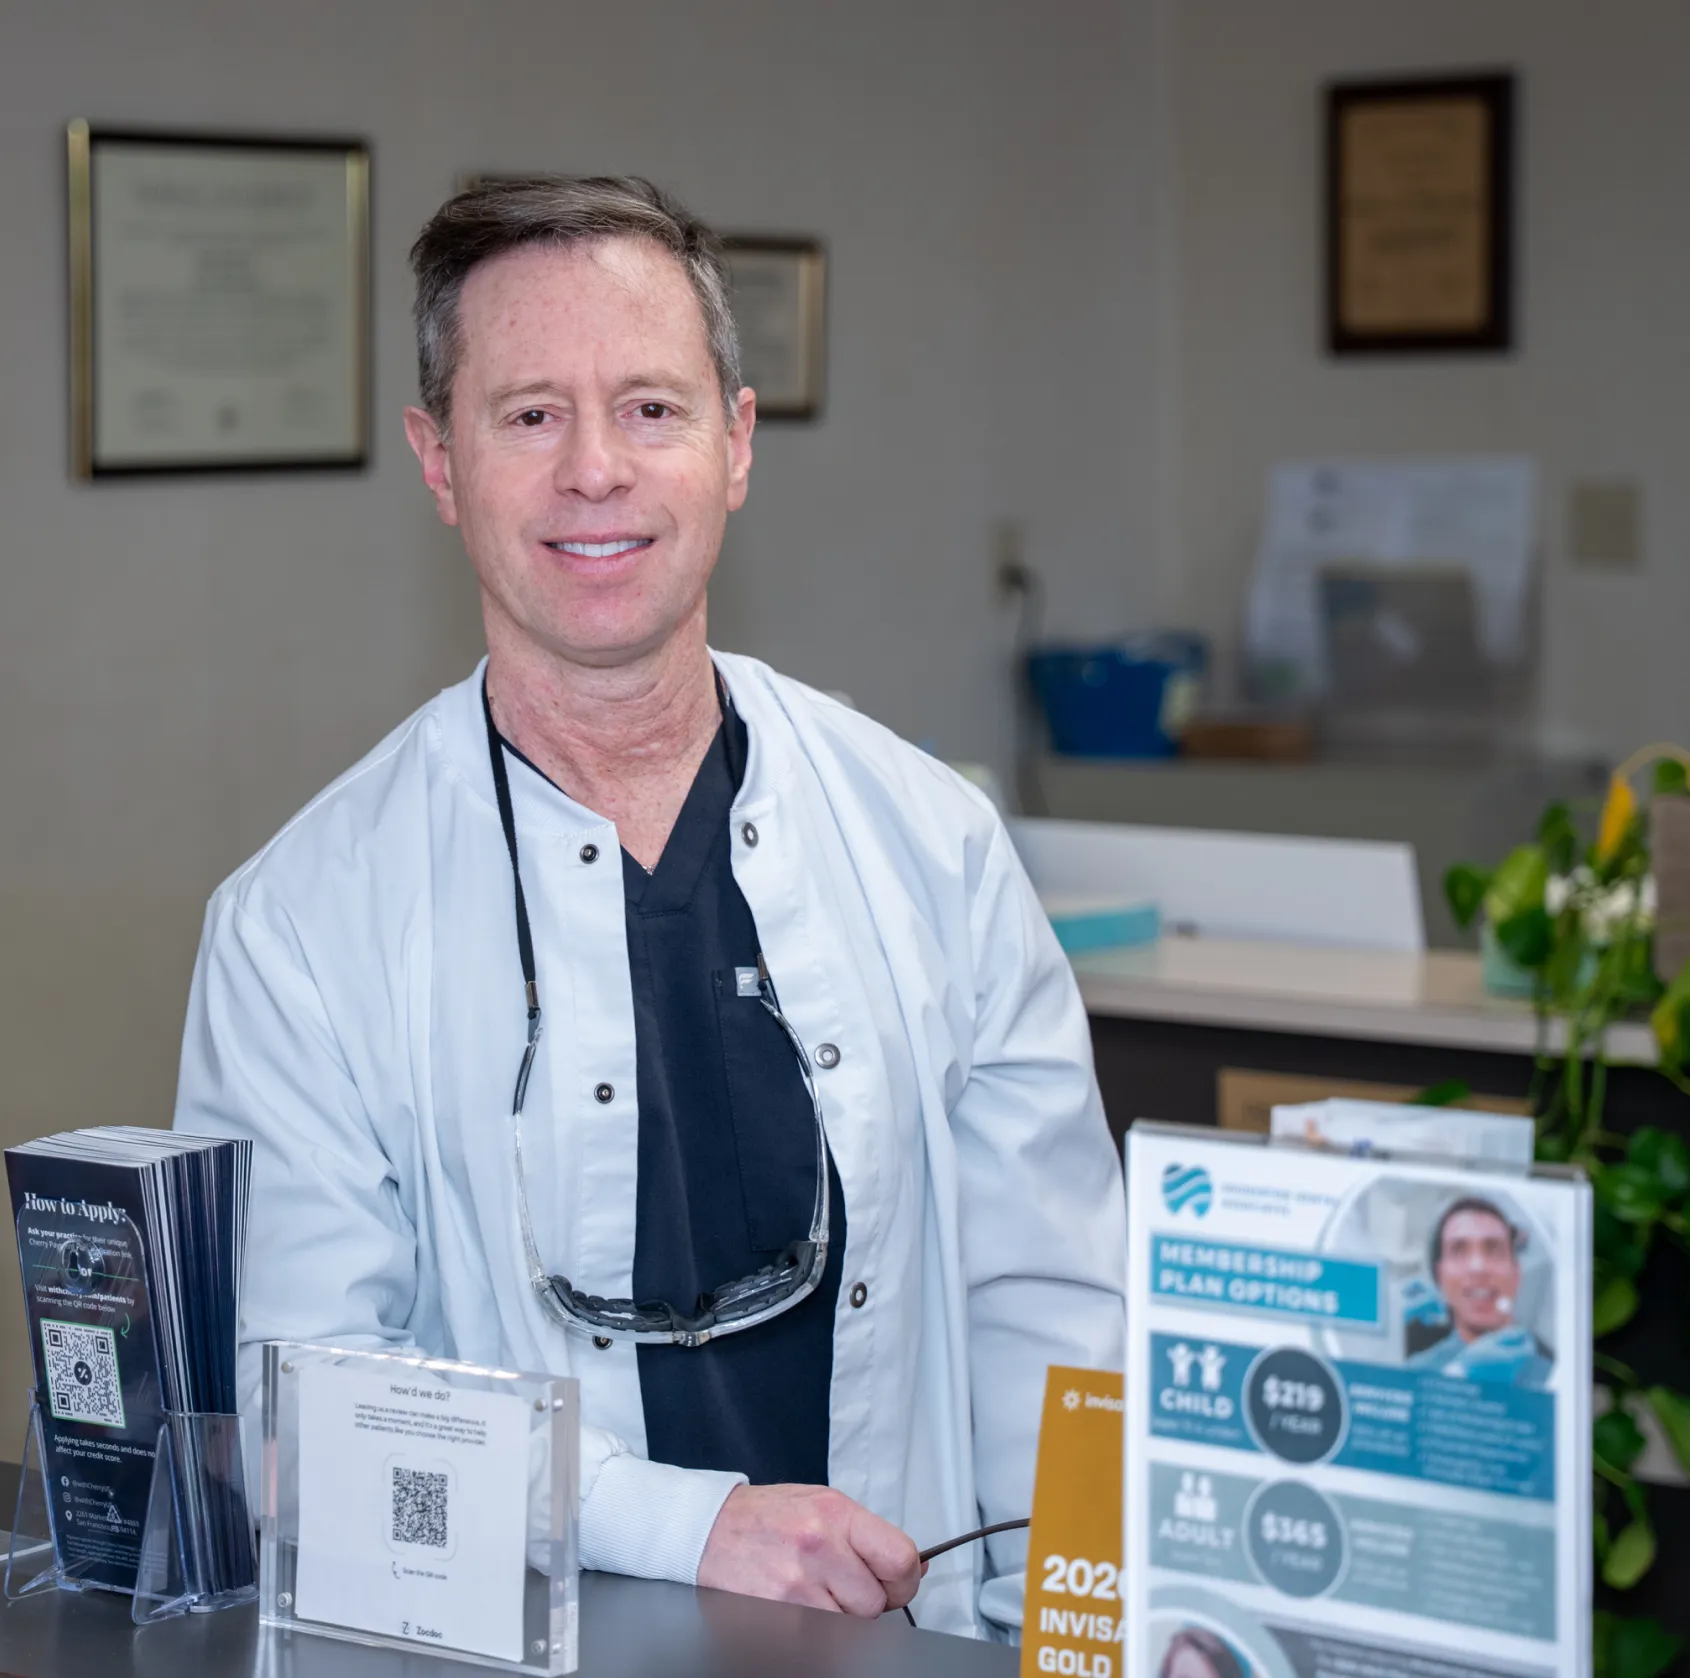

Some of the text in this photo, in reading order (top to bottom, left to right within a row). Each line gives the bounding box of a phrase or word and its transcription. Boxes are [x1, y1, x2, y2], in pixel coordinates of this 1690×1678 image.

[24, 1192, 126, 1225] How to Apply:
[28, 1227, 40, 1236] Ask
[40, 1230, 55, 1239] your
[28, 1238, 48, 1249] Cherry
[1160, 1241, 1323, 1282] MEMBERSHIP
[35, 1284, 47, 1292] Visit
[127, 1297, 135, 1306] by
[36, 1295, 62, 1308] scanning
[63, 1299, 72, 1307] the
[73, 1300, 82, 1309] QR
[83, 1302, 97, 1311] code
[1160, 1269, 1340, 1315] PLAN OPTIONS
[390, 1384, 451, 1401] How'd we do?
[1085, 1391, 1124, 1413] invisa
[1160, 1388, 1234, 1419] CHILD
[1263, 1374, 1325, 1412] $219
[54, 1434, 79, 1447] Applying
[80, 1439, 95, 1448] takes
[96, 1442, 120, 1452] seconds
[120, 1445, 132, 1454] and
[133, 1447, 147, 1456] does
[55, 1446, 72, 1455] affect
[73, 1449, 86, 1458] your
[87, 1451, 104, 1460] credit
[1158, 1518, 1235, 1549] ADULT
[1260, 1511, 1328, 1549] $365
[416, 1626, 443, 1639] Zocdoc
[1039, 1607, 1129, 1644] INVISA
[1037, 1646, 1112, 1678] GOLD
